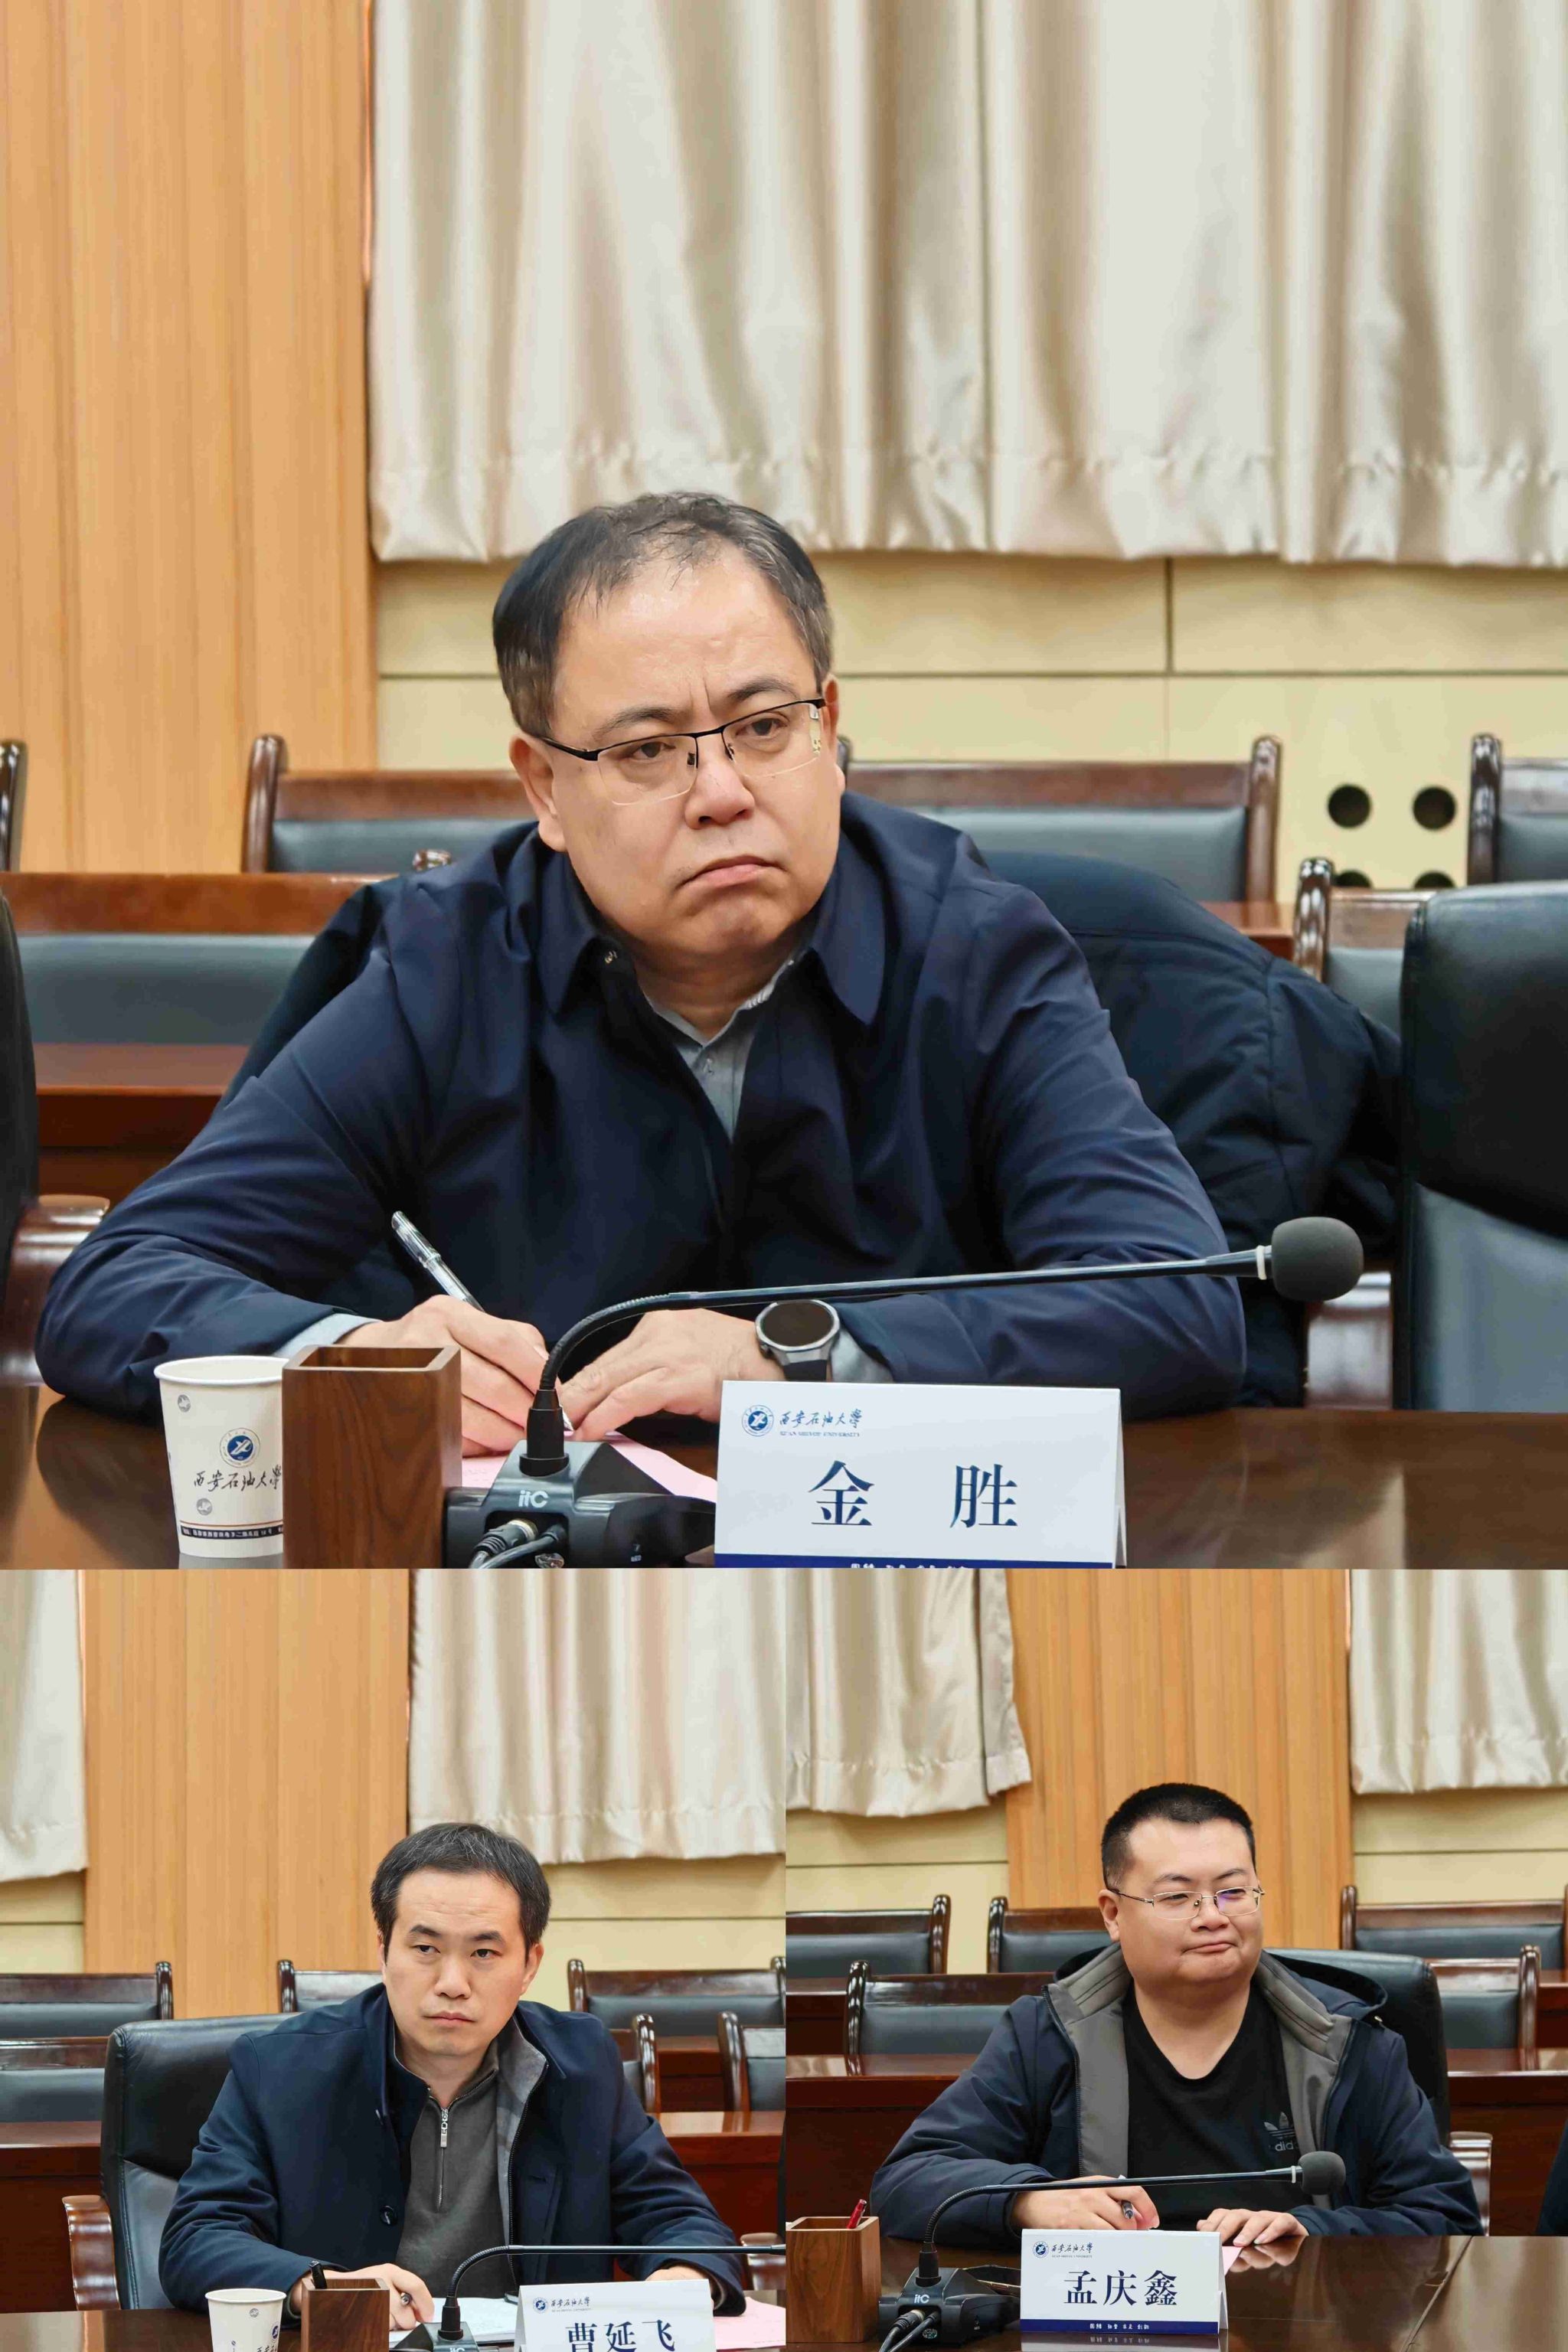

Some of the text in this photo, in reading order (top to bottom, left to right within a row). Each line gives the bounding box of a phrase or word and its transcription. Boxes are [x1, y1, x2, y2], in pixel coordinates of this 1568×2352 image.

[1063, 2269, 1178, 2306] 孟庆鑫
[565, 2319, 675, 2352] 曹延飞
